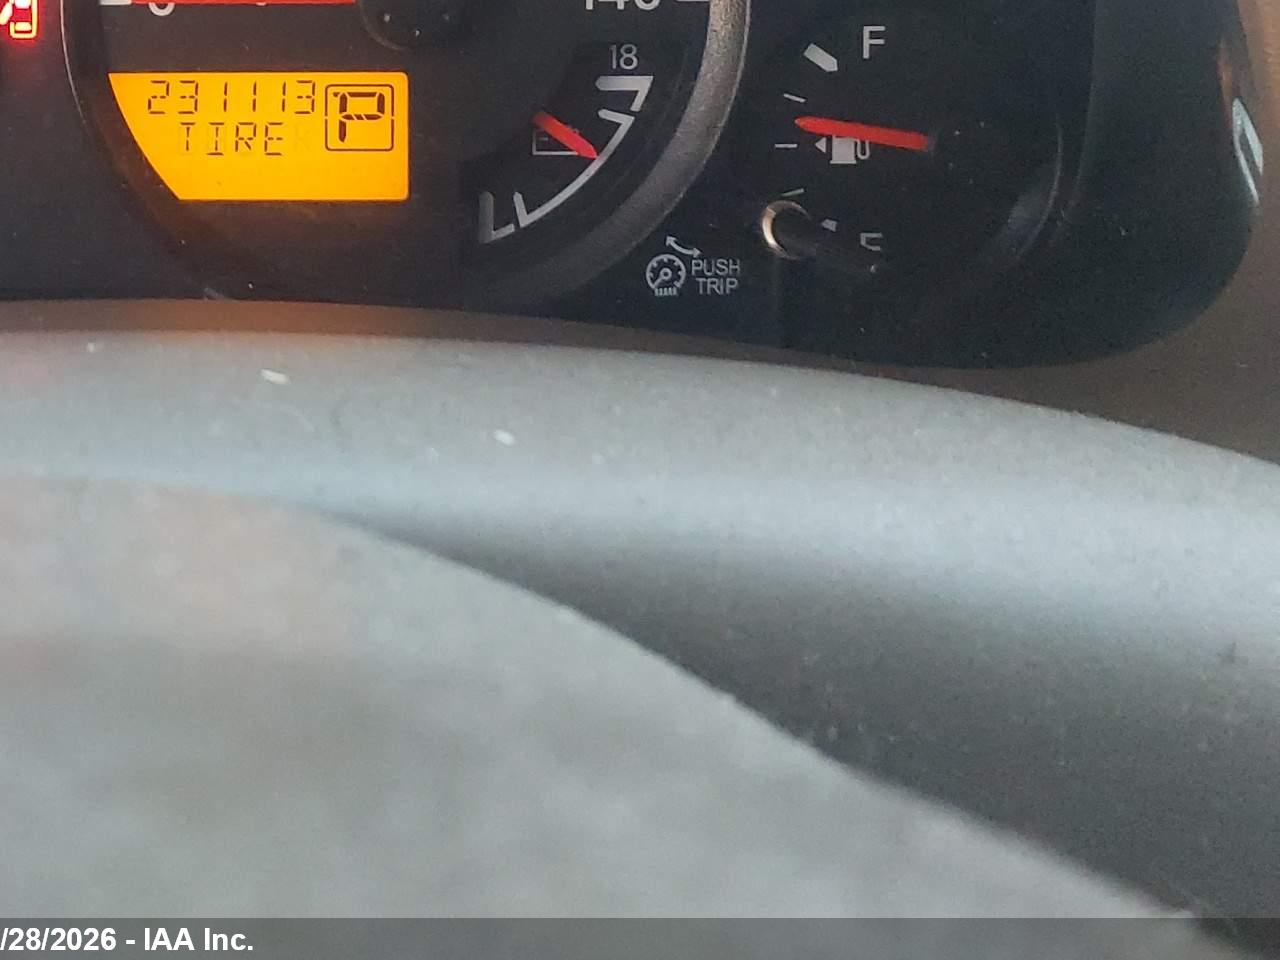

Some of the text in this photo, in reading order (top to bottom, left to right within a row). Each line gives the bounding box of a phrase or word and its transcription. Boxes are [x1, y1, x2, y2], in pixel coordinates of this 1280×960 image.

[613, 45, 637, 69] 18
[863, 26, 885, 58] F
[148, 80, 316, 114] 231113
[333, 92, 385, 143] P
[180, 122, 283, 156] TIRE
[691, 259, 741, 276] PUSH
[696, 278, 738, 294] TRIP
